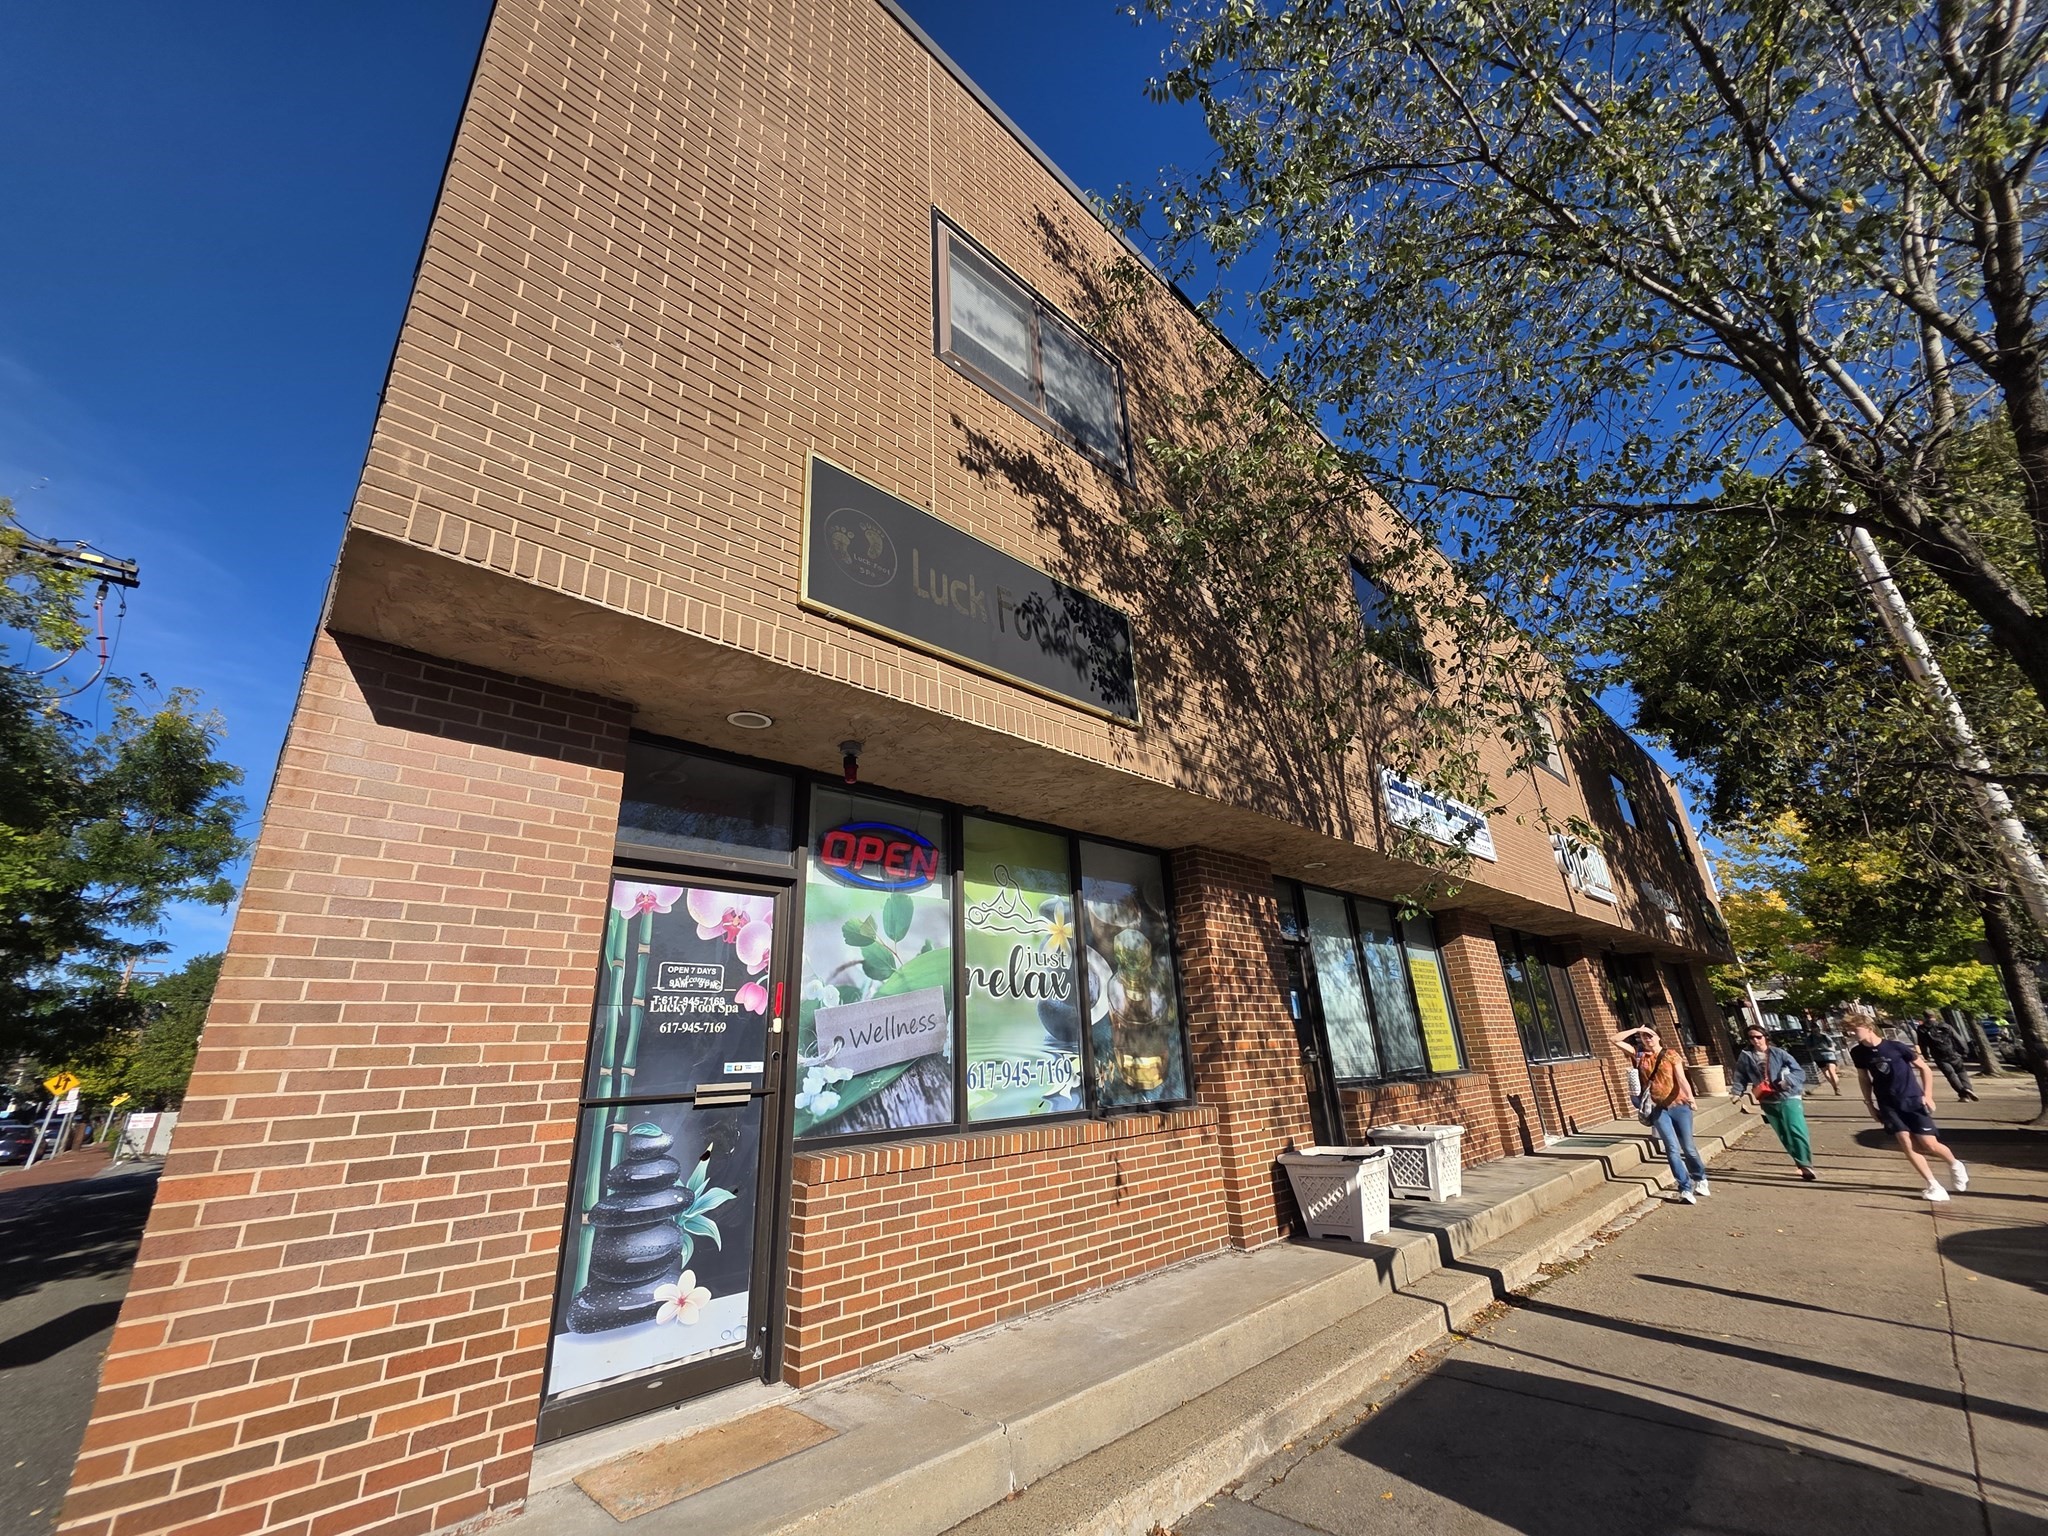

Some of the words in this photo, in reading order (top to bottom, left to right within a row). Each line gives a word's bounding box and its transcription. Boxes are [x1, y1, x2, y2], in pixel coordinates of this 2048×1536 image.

[912, 547, 987, 624] Luck
[821, 830, 940, 882] OPEN
[667, 965, 689, 974] OPEN
[697, 967, 717, 975] DAYS
[966, 944, 1071, 1000] relax
[1025, 946, 1068, 972] just
[649, 1000, 687, 1016] Lucky
[718, 1003, 739, 1016] Spa
[659, 1021, 727, 1034] 617-945-7169
[849, 1011, 937, 1050] Wellness
[966, 1058, 1073, 1091] 617-945-7169
